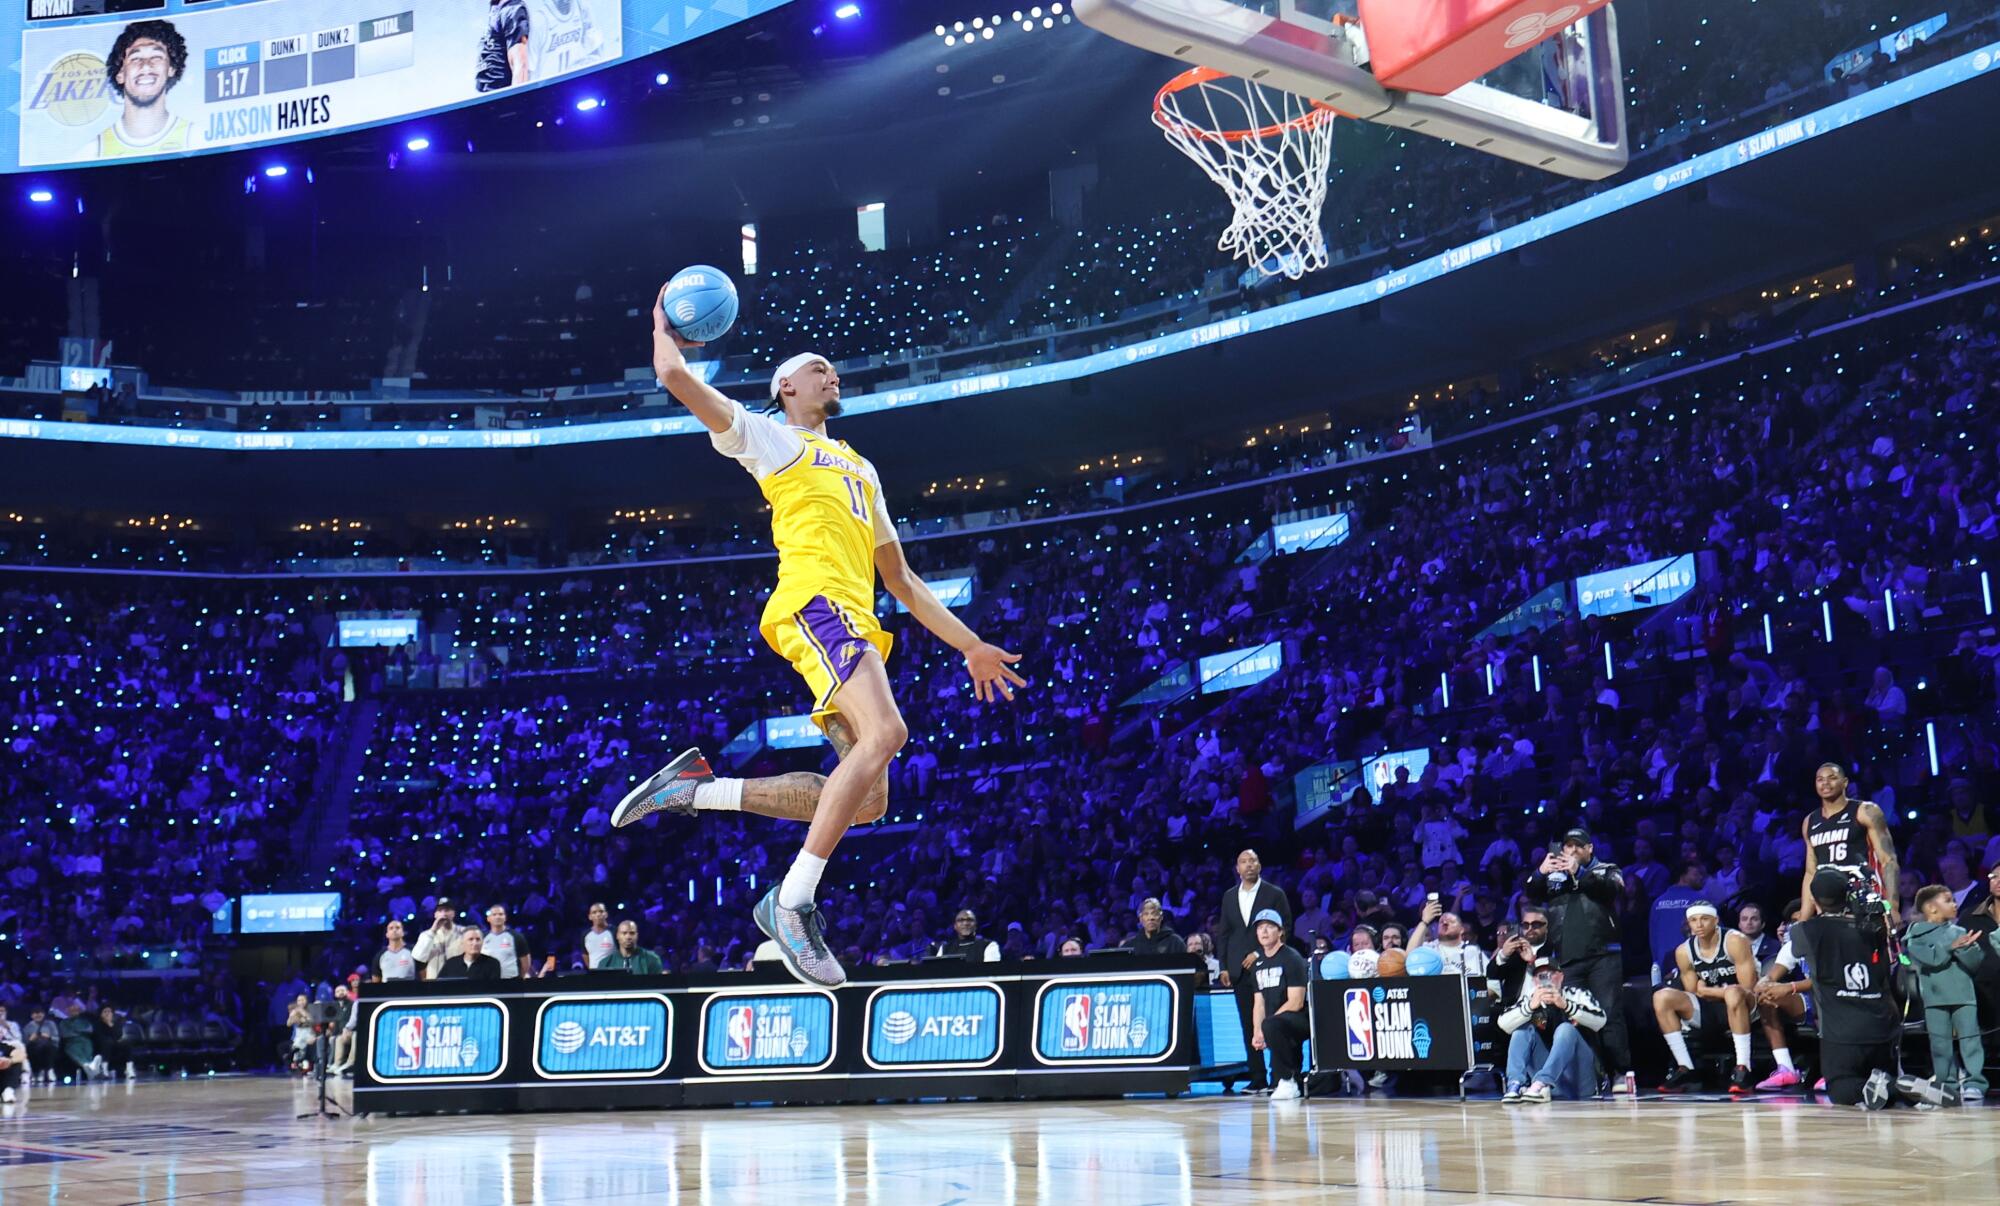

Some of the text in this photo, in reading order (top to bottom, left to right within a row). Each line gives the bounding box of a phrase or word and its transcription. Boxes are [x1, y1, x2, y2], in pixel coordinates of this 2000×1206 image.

[31, 0, 73, 17] BRYANT
[318, 28, 349, 48] DUNK 2
[372, 17, 400, 38] TOTAL
[217, 46, 248, 66] CLOCK
[271, 38, 301, 57] DUNK 1
[29, 73, 123, 110] LAKER
[217, 67, 249, 98] 1:17
[204, 95, 330, 141] JAXSON HAYES
[1749, 120, 1804, 156] SLAM DUNK
[1668, 166, 1694, 185] AT&T
[1387, 273, 1408, 290] AT&T
[811, 447, 863, 475] LAKE
[843, 476, 868, 522] 11
[1594, 588, 1616, 601] AT&T
[1657, 571, 1680, 591] DUNK
[1810, 828, 1849, 848] MIAMI
[1829, 843, 1848, 863] 16
[1658, 899, 1690, 908] SECURITY
[1108, 993, 1132, 1003] AT&T
[1386, 988, 1410, 1000] AT&T
[1476, 990, 1488, 998] AT&T
[770, 1004, 793, 1014] AT&T
[1093, 1004, 1132, 1027] SLAM
[1374, 1002, 1413, 1031] SLAM
[1478, 1015, 1490, 1024] AT&T
[440, 1015, 463, 1025] AT&T
[755, 1015, 792, 1037] SLAM
[921, 1014, 984, 1037] AT&T
[425, 1025, 463, 1047] SLAM
[589, 1026, 651, 1047] AT&T
[1091, 1026, 1130, 1050] DUNK
[1376, 1030, 1415, 1059] DUNK
[1480, 1042, 1492, 1050] AT&T
[424, 1046, 462, 1068] DUNK
[754, 1036, 791, 1059] DUNK
